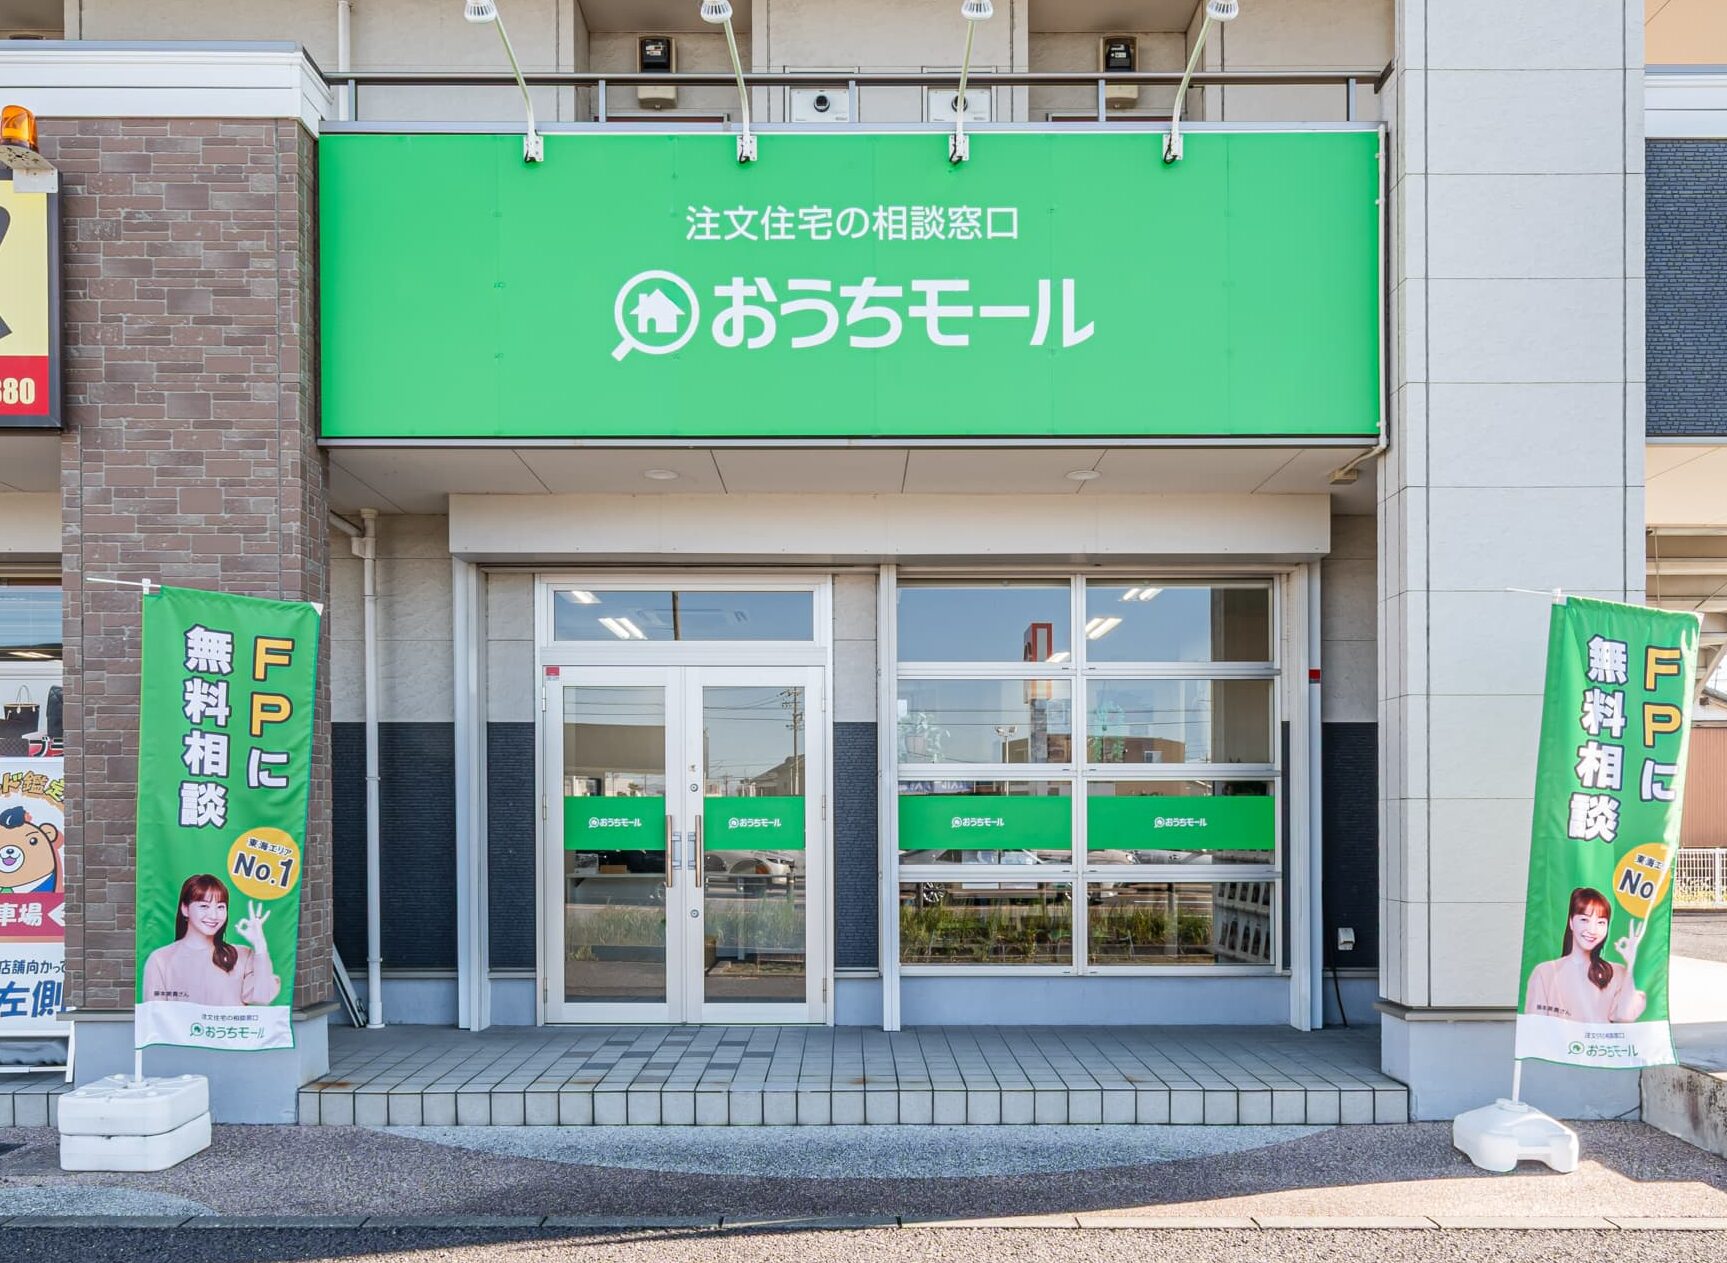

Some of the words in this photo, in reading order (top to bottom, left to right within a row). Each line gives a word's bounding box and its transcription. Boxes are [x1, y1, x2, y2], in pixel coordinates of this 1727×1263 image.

[685, 204, 1019, 242] 注文住宅の相談窓口
[711, 276, 1095, 349] おうちモール
[0, 377, 36, 405] 80
[178, 624, 235, 828] 無料相談
[247, 637, 295, 789] FPに
[1640, 646, 1682, 801] FPに
[1567, 634, 1629, 843] 無料相談
[600, 817, 642, 828] おうちモール
[739, 817, 782, 828] おうちモール
[962, 817, 1005, 828] おうちモール
[1165, 817, 1208, 828] おうちモール
[233, 852, 294, 888] No.1
[0, 980, 66, 1018] 左側
[205, 1025, 265, 1039] おうちモール
